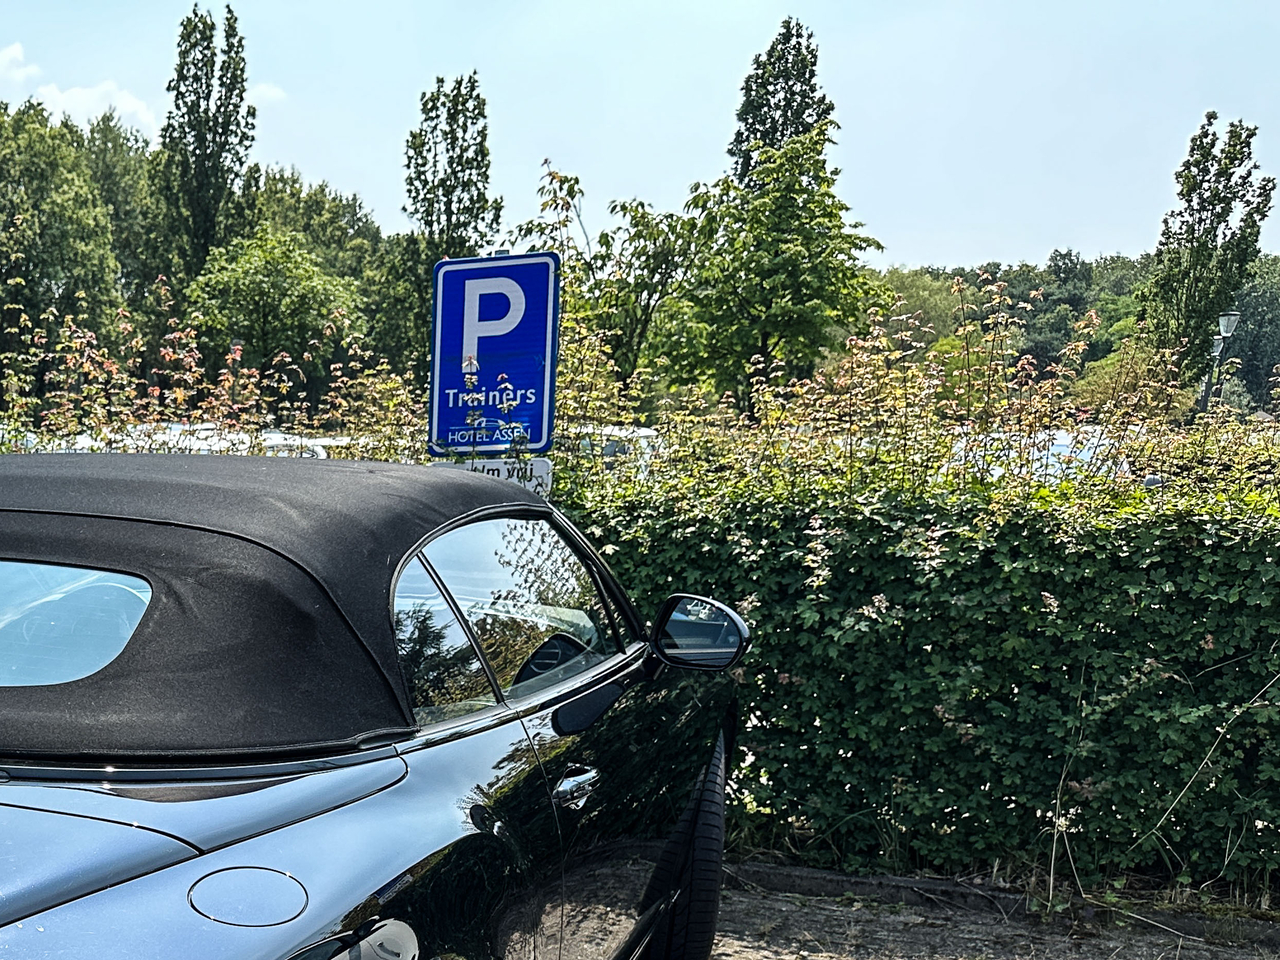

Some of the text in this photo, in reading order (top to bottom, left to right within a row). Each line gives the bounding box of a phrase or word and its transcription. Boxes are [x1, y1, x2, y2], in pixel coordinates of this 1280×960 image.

[462, 277, 526, 373] P
[445, 387, 536, 408] Trainers
[448, 430, 490, 443] HOTEL
